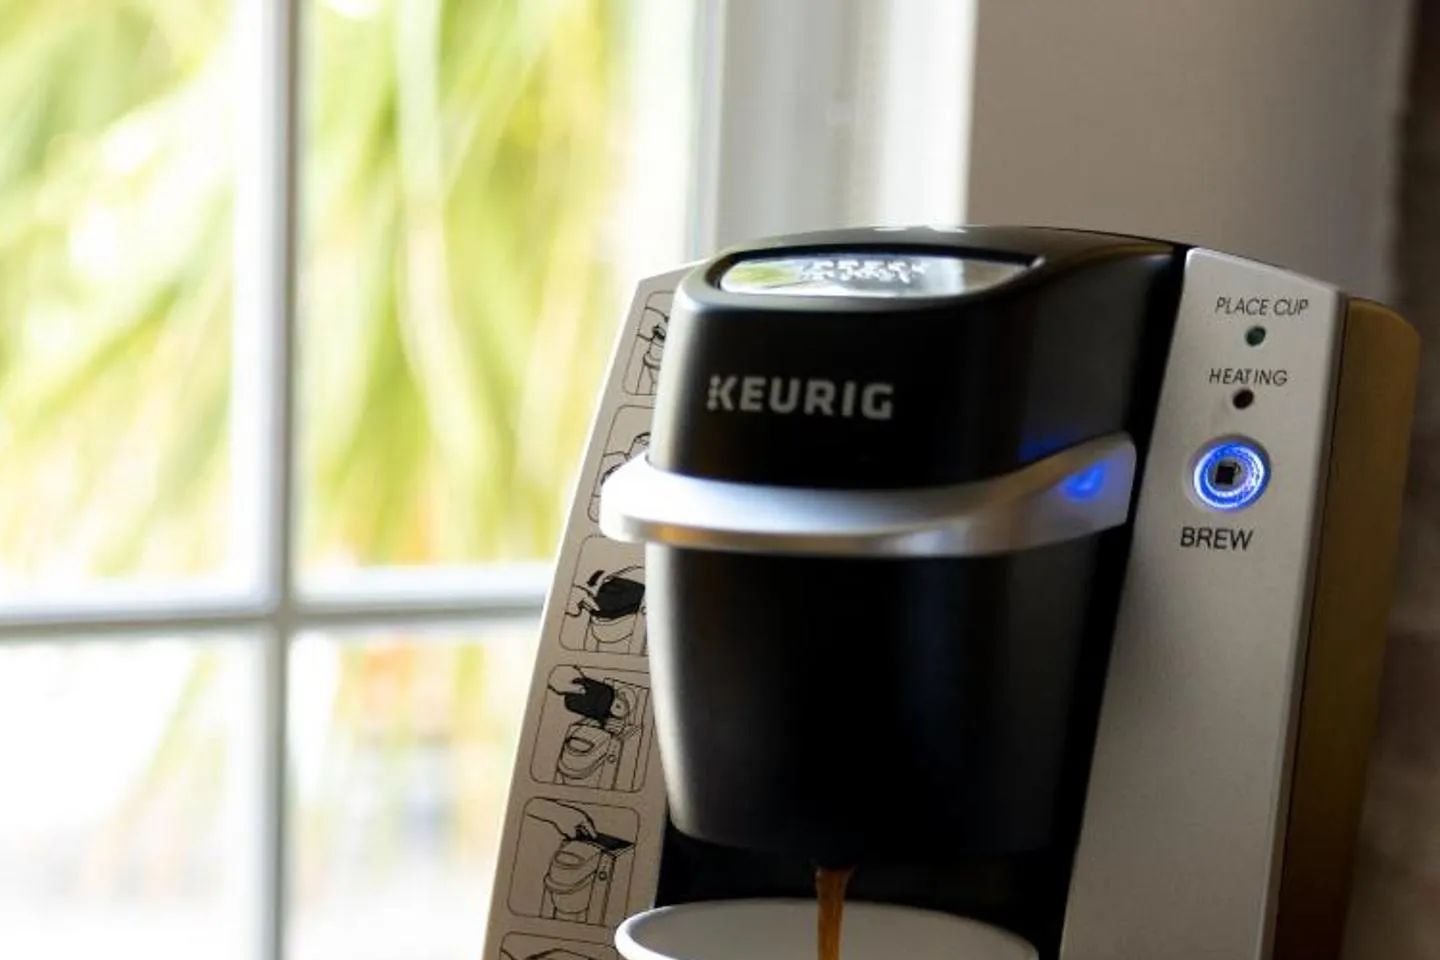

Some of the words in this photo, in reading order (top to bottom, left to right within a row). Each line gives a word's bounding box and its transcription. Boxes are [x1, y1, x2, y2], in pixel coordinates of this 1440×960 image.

[1214, 296, 1270, 316] PLACE
[1273, 298, 1309, 316] CUP
[1208, 367, 1288, 387] HEATING
[706, 373, 894, 421] KEURIG
[1180, 526, 1254, 551] BREW
